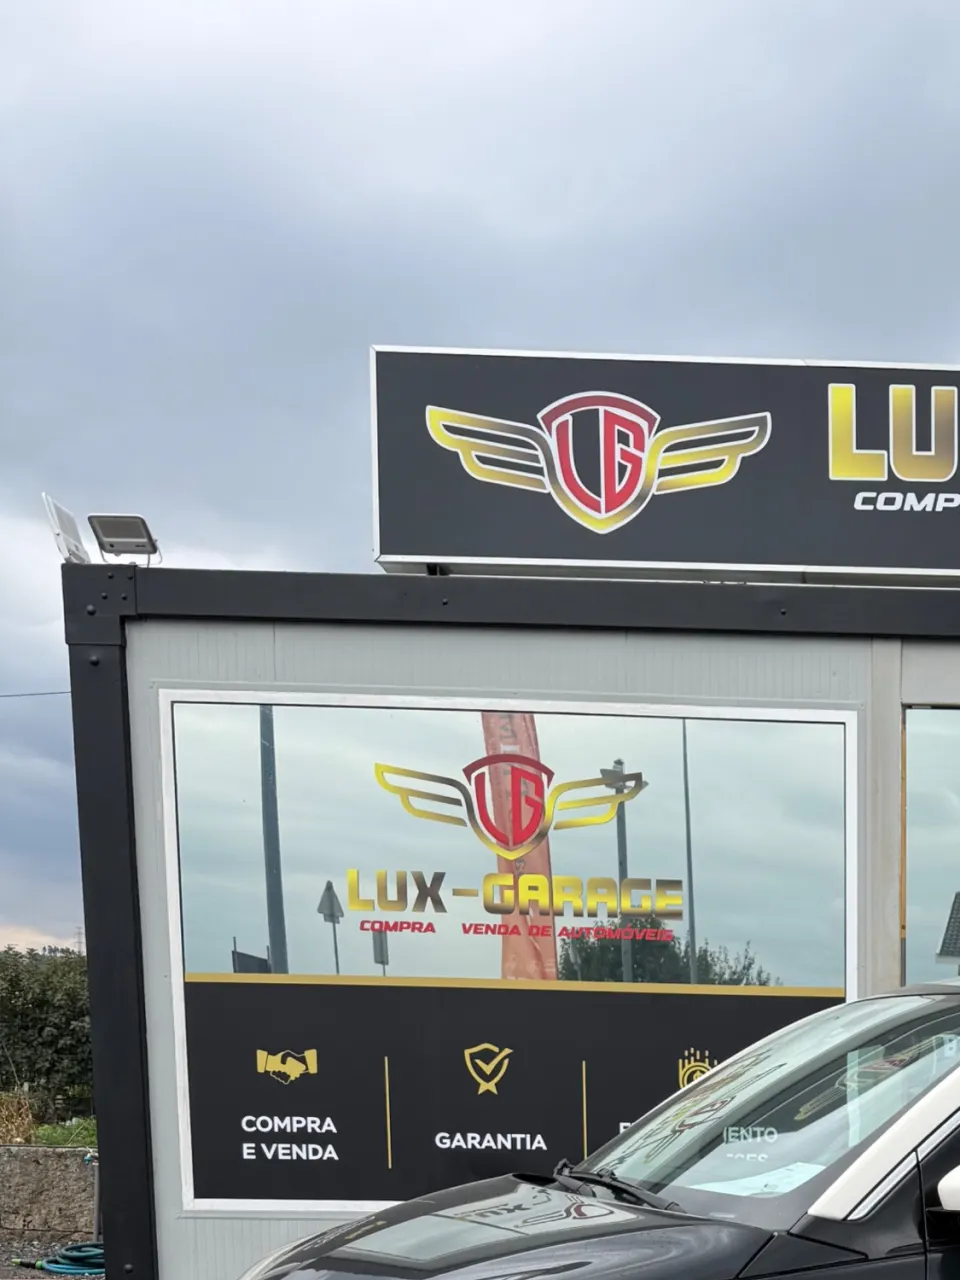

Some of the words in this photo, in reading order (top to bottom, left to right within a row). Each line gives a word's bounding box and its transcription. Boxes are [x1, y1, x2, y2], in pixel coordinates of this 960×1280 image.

[347, 868, 683, 921] LUX-GARAGE
[359, 919, 437, 934] COMPRA
[461, 922, 523, 937] VENDA
[528, 924, 553, 938] DE
[557, 923, 674, 942] AUTOMÓVEIS
[241, 1115, 338, 1134] COMPRA
[434, 1131, 548, 1151] GARANTIA
[242, 1142, 256, 1160] E
[260, 1143, 340, 1161] VENDA
